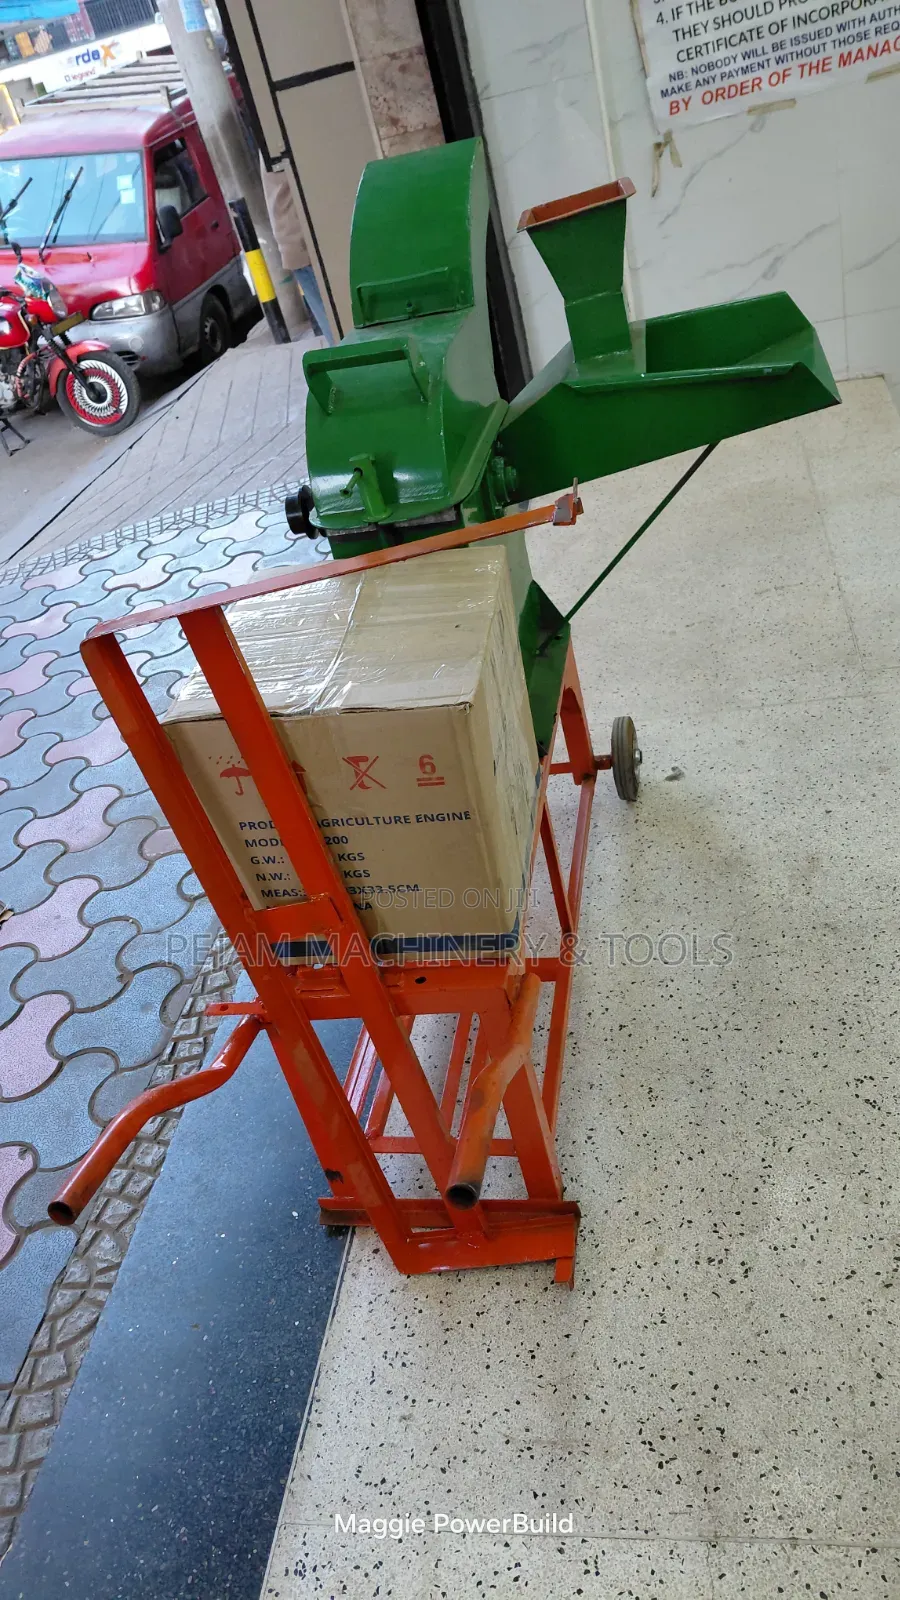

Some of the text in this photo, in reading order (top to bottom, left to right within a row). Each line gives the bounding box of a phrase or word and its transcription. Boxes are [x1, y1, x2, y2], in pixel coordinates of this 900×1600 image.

[656, 0, 715, 25] 4. IF THE
[672, 19, 710, 42] THEY
[713, 1, 774, 31] SHOULD
[669, 70, 688, 83] NB:
[691, 53, 738, 76] NOBODY
[741, 46, 768, 61] WILL
[772, 39, 787, 52] BE
[790, 26, 833, 47] ISSUED
[836, 15, 866, 33] WITH
[676, 25, 765, 63] CERTIFICATE
[768, 18, 788, 36] OF
[660, 81, 693, 98] MAKE
[695, 75, 717, 89] ANY
[720, 58, 771, 82] PAYMENT
[775, 42, 827, 65] WITHOUT
[830, 29, 871, 49] THOSE
[669, 95, 692, 116] BY
[701, 76, 762, 105] ORDER
[768, 67, 792, 87] OF
[798, 56, 832, 79] THE
[418, 754, 437, 775] 6
[416, 811, 472, 824] ENGINE
[250, 852, 365, 865] G.W.: KGS
[256, 869, 371, 882] N.W.: KGS
